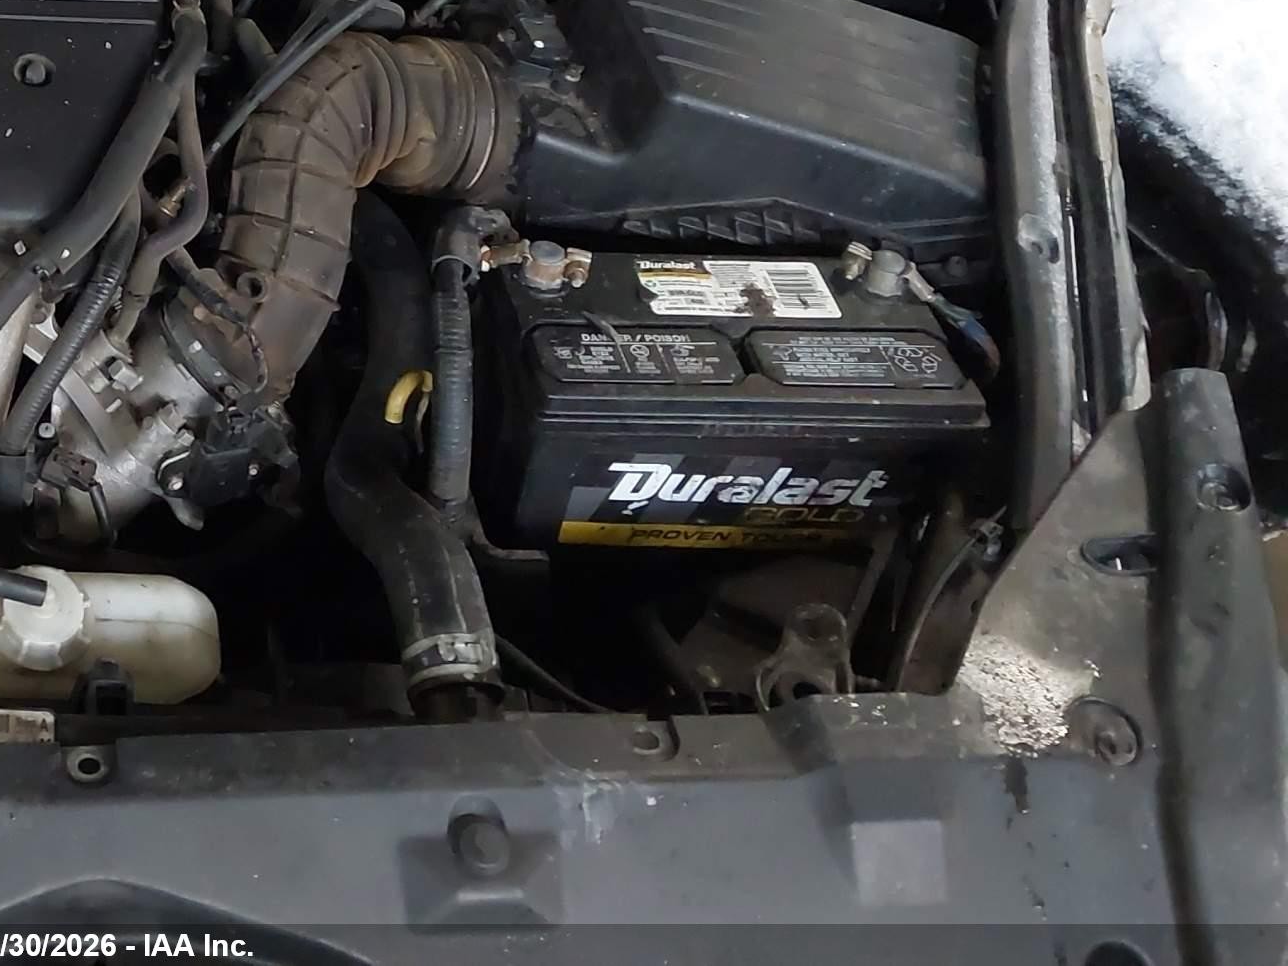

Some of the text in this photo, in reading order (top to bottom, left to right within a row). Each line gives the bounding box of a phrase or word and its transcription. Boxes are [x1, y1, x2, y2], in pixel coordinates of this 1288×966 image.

[636, 260, 697, 270] Duralast
[580, 333, 633, 342] DANER
[643, 333, 691, 343] POISON
[607, 462, 890, 508] Duralast
[743, 507, 865, 523] GOLD
[630, 528, 733, 542] PROVEN
